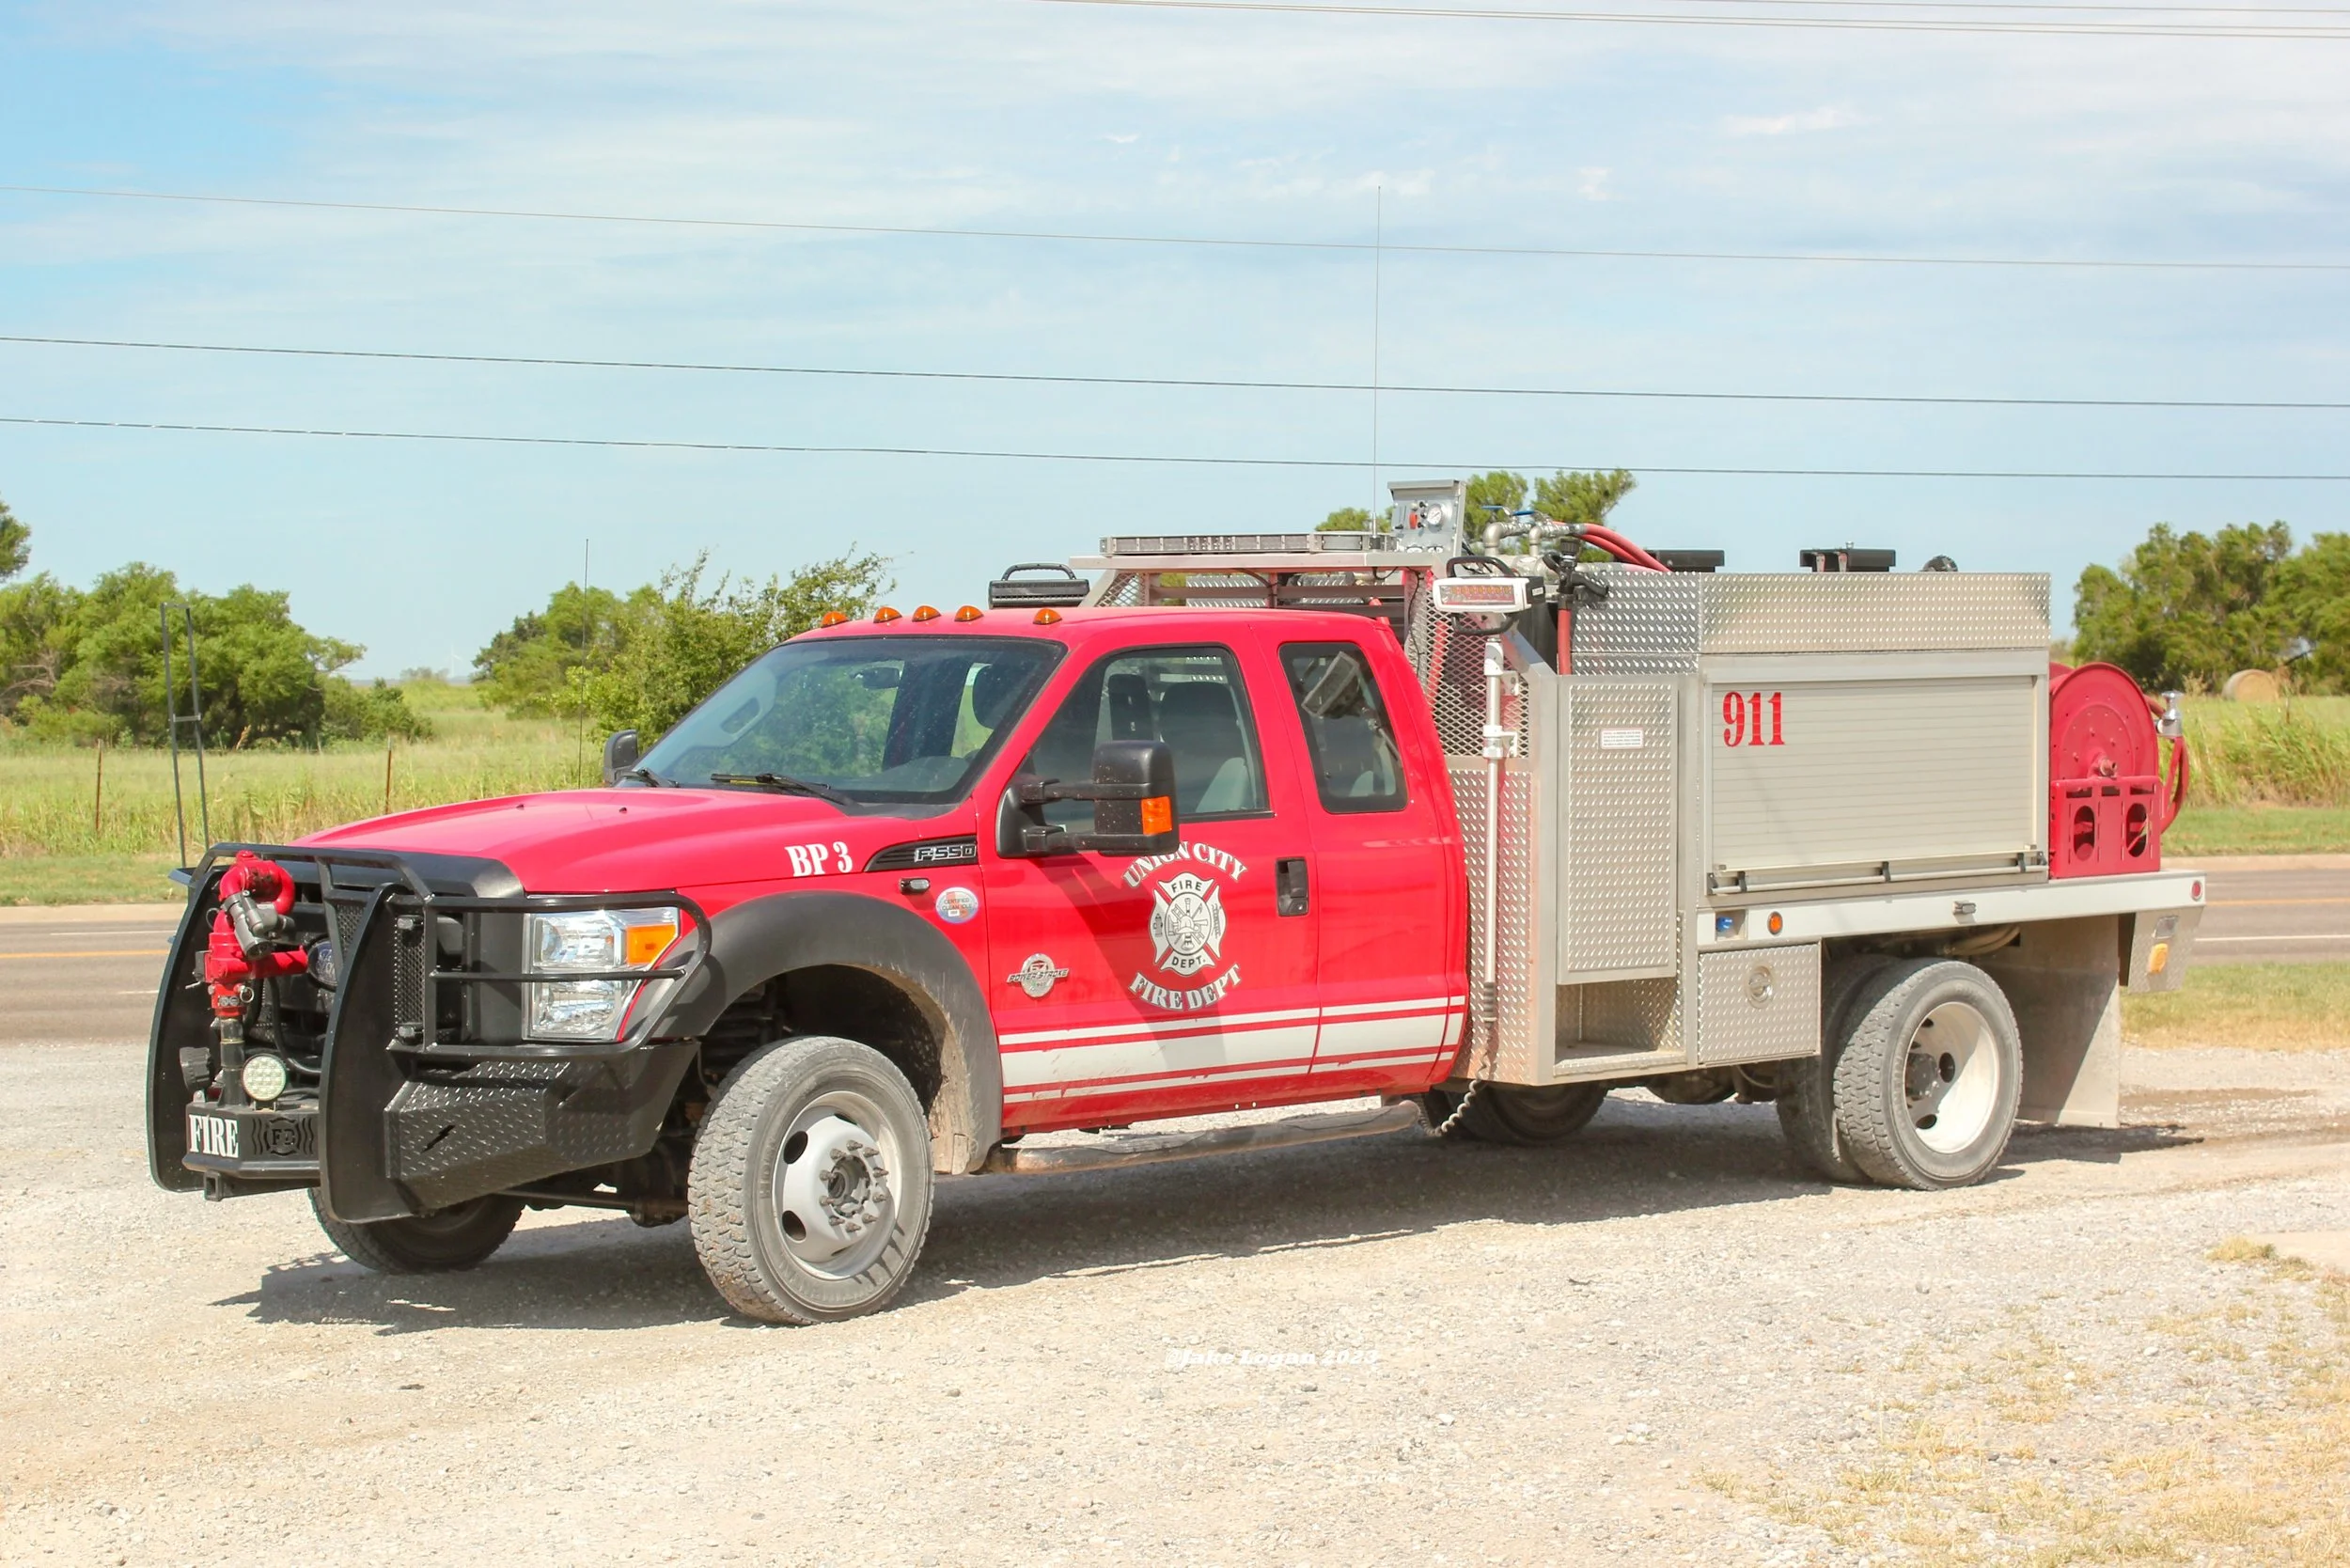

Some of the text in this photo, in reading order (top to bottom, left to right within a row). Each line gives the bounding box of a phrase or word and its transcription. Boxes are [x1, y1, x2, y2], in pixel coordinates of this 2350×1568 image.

[1722, 691, 1785, 747] 911
[785, 840, 854, 877] BP 3
[914, 843, 977, 862] F-550
[1193, 842, 1247, 882] CITY
[1171, 879, 1202, 894] FIRE
[1009, 969, 1069, 981] POWER STROKE
[1171, 955, 1207, 968] DEPT.
[1129, 964, 1242, 1011] FIRE DEPT
[188, 1114, 239, 1158] FIRE
